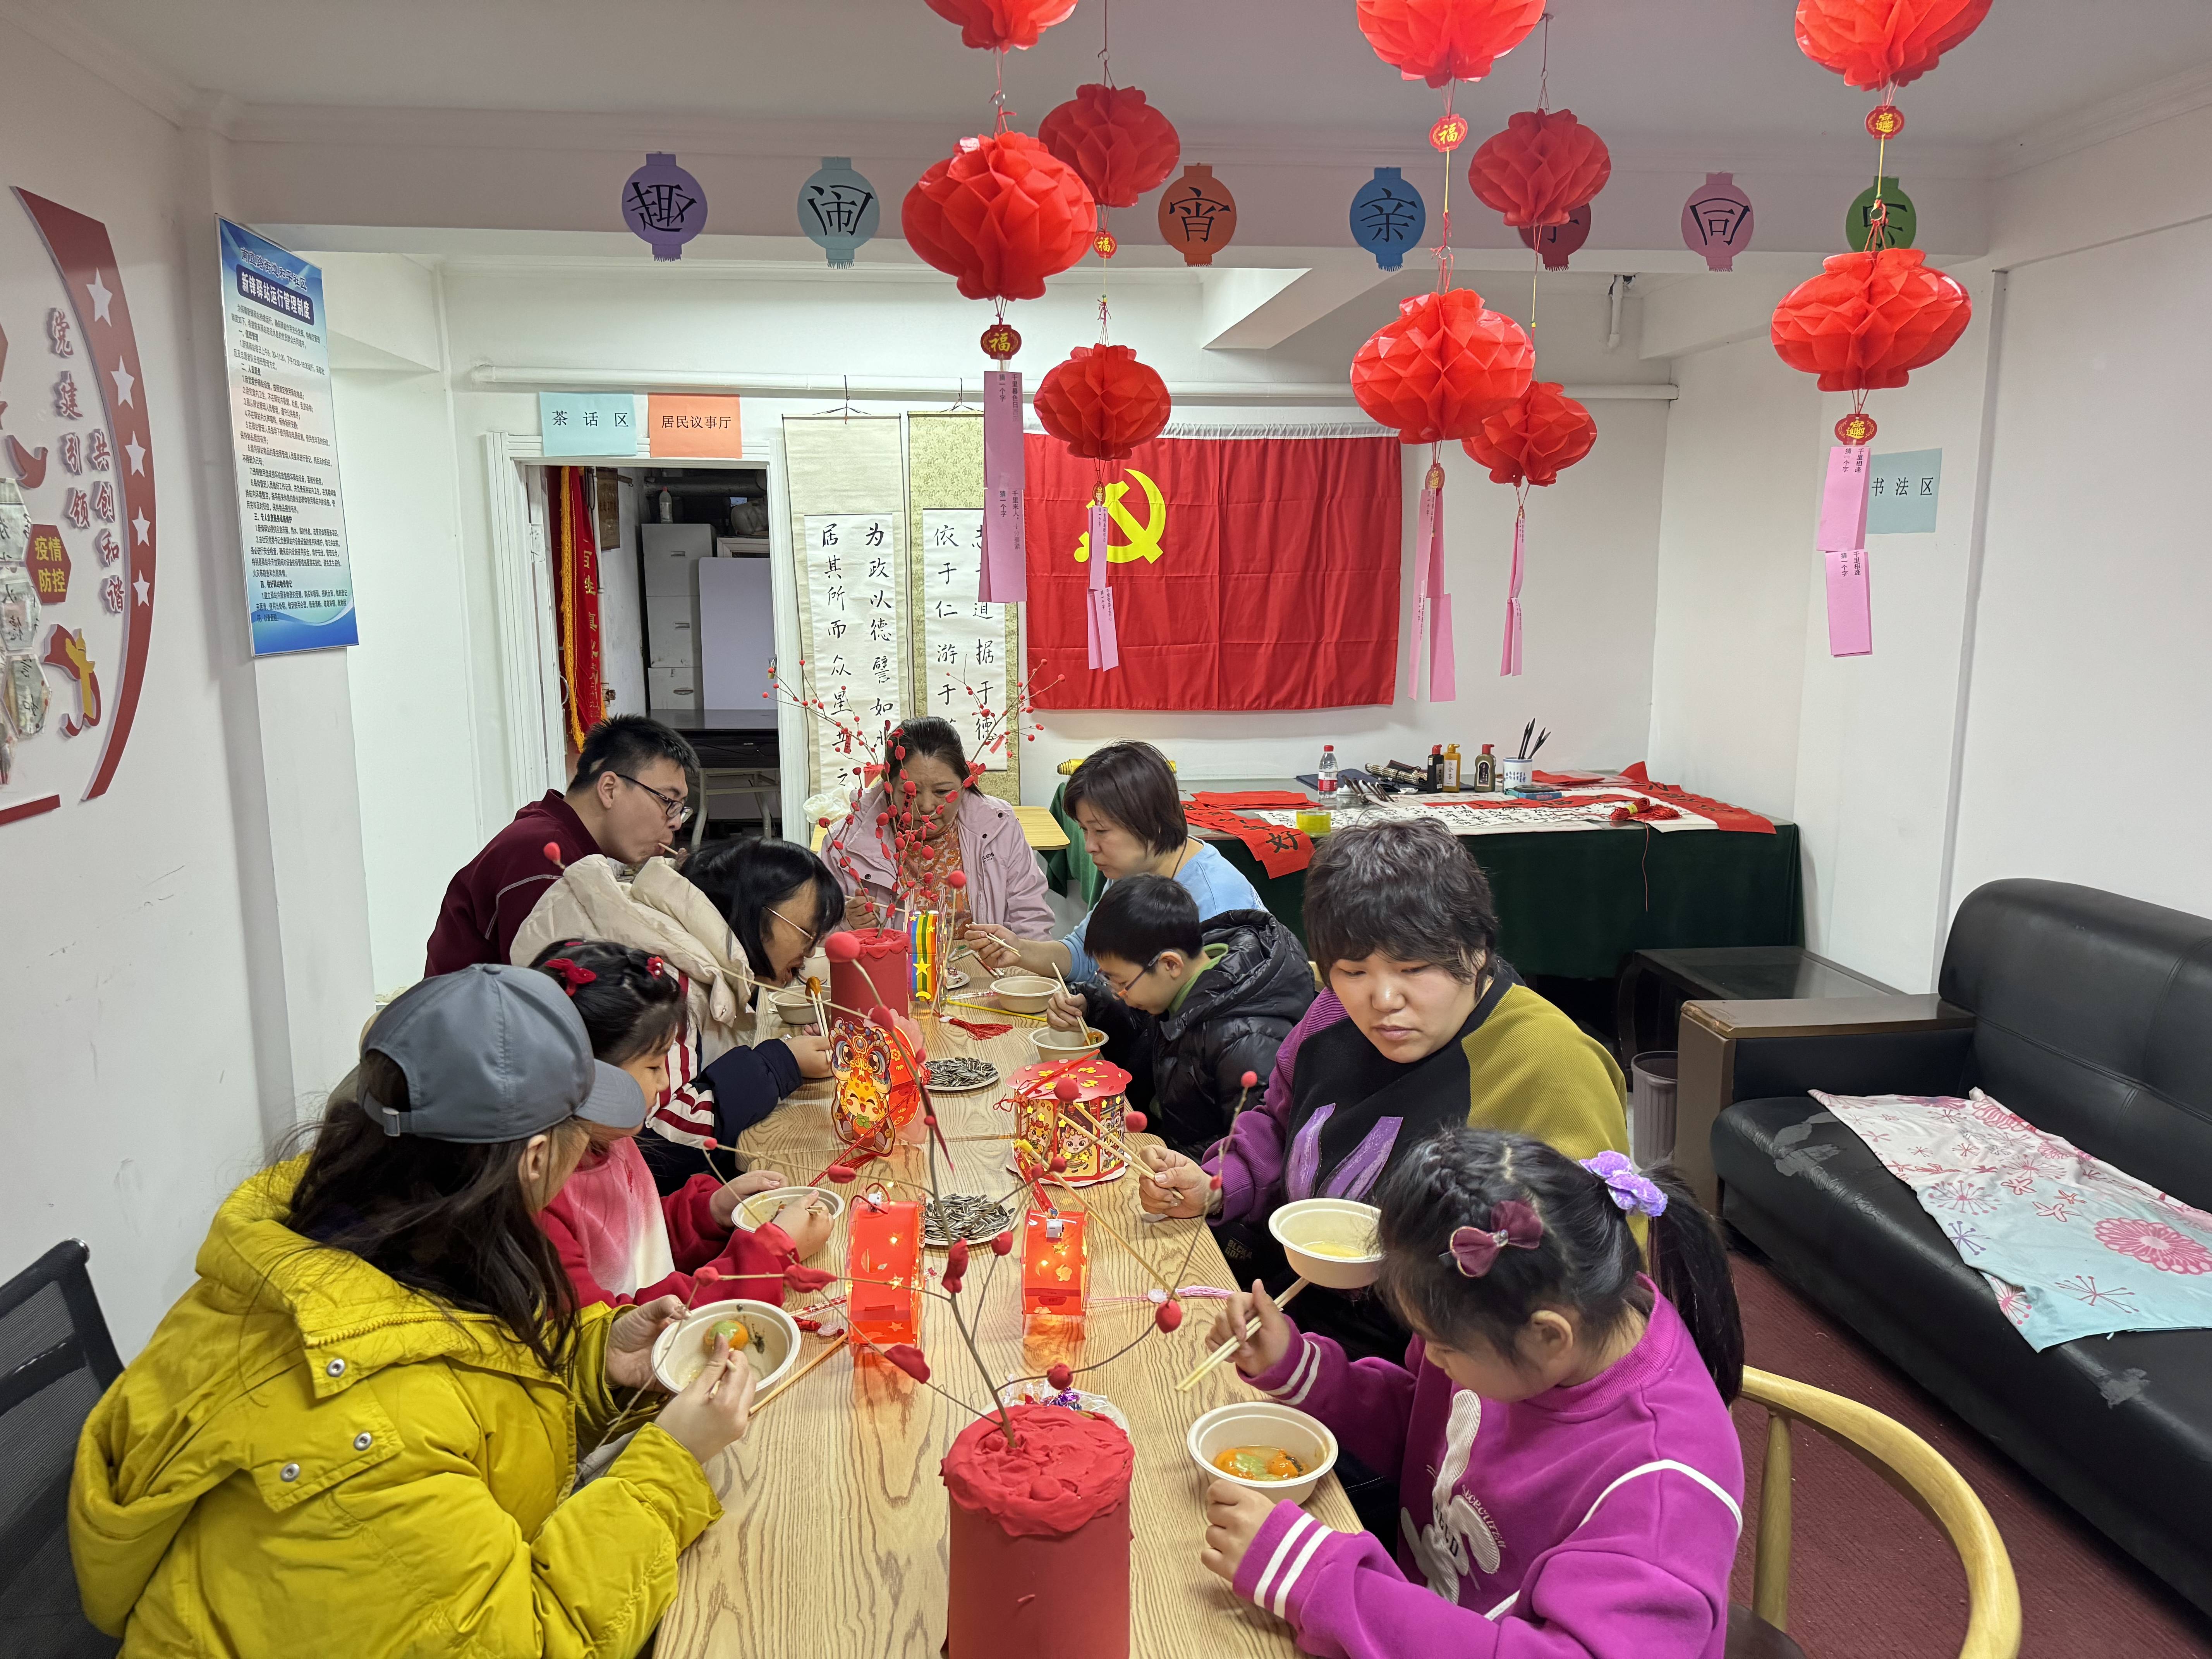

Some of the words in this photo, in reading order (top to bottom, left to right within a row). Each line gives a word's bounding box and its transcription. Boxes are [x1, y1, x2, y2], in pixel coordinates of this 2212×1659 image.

[1438, 122, 1458, 144] 福
[627, 182, 697, 232] 趣
[807, 184, 874, 236] 闹
[1169, 186, 1231, 242] 宵
[1359, 187, 1418, 242] 亲
[1689, 198, 1751, 246] 同
[1863, 203, 1907, 248] 乐
[1097, 237, 1111, 252] 福
[240, 247, 307, 291] 南直路街道和平社区
[241, 271, 311, 320] 新锋驿站运行管理制度
[988, 333, 1011, 352] 福
[53, 309, 90, 528] 党建引领
[552, 410, 629, 427] 茶话区
[661, 415, 732, 429] 居民议事厅
[1842, 448, 1851, 472] 猜一个字
[1855, 448, 1865, 473] 千里相逢
[1872, 477, 1934, 497] 书法区
[92, 430, 125, 613] 共创和谐
[34, 536, 62, 561] 疫情
[39, 568, 66, 593] 防控
[933, 527, 959, 726] 依于仁游于
[971, 524, 998, 741] 道据于德
[1266, 831, 1301, 853] 好
